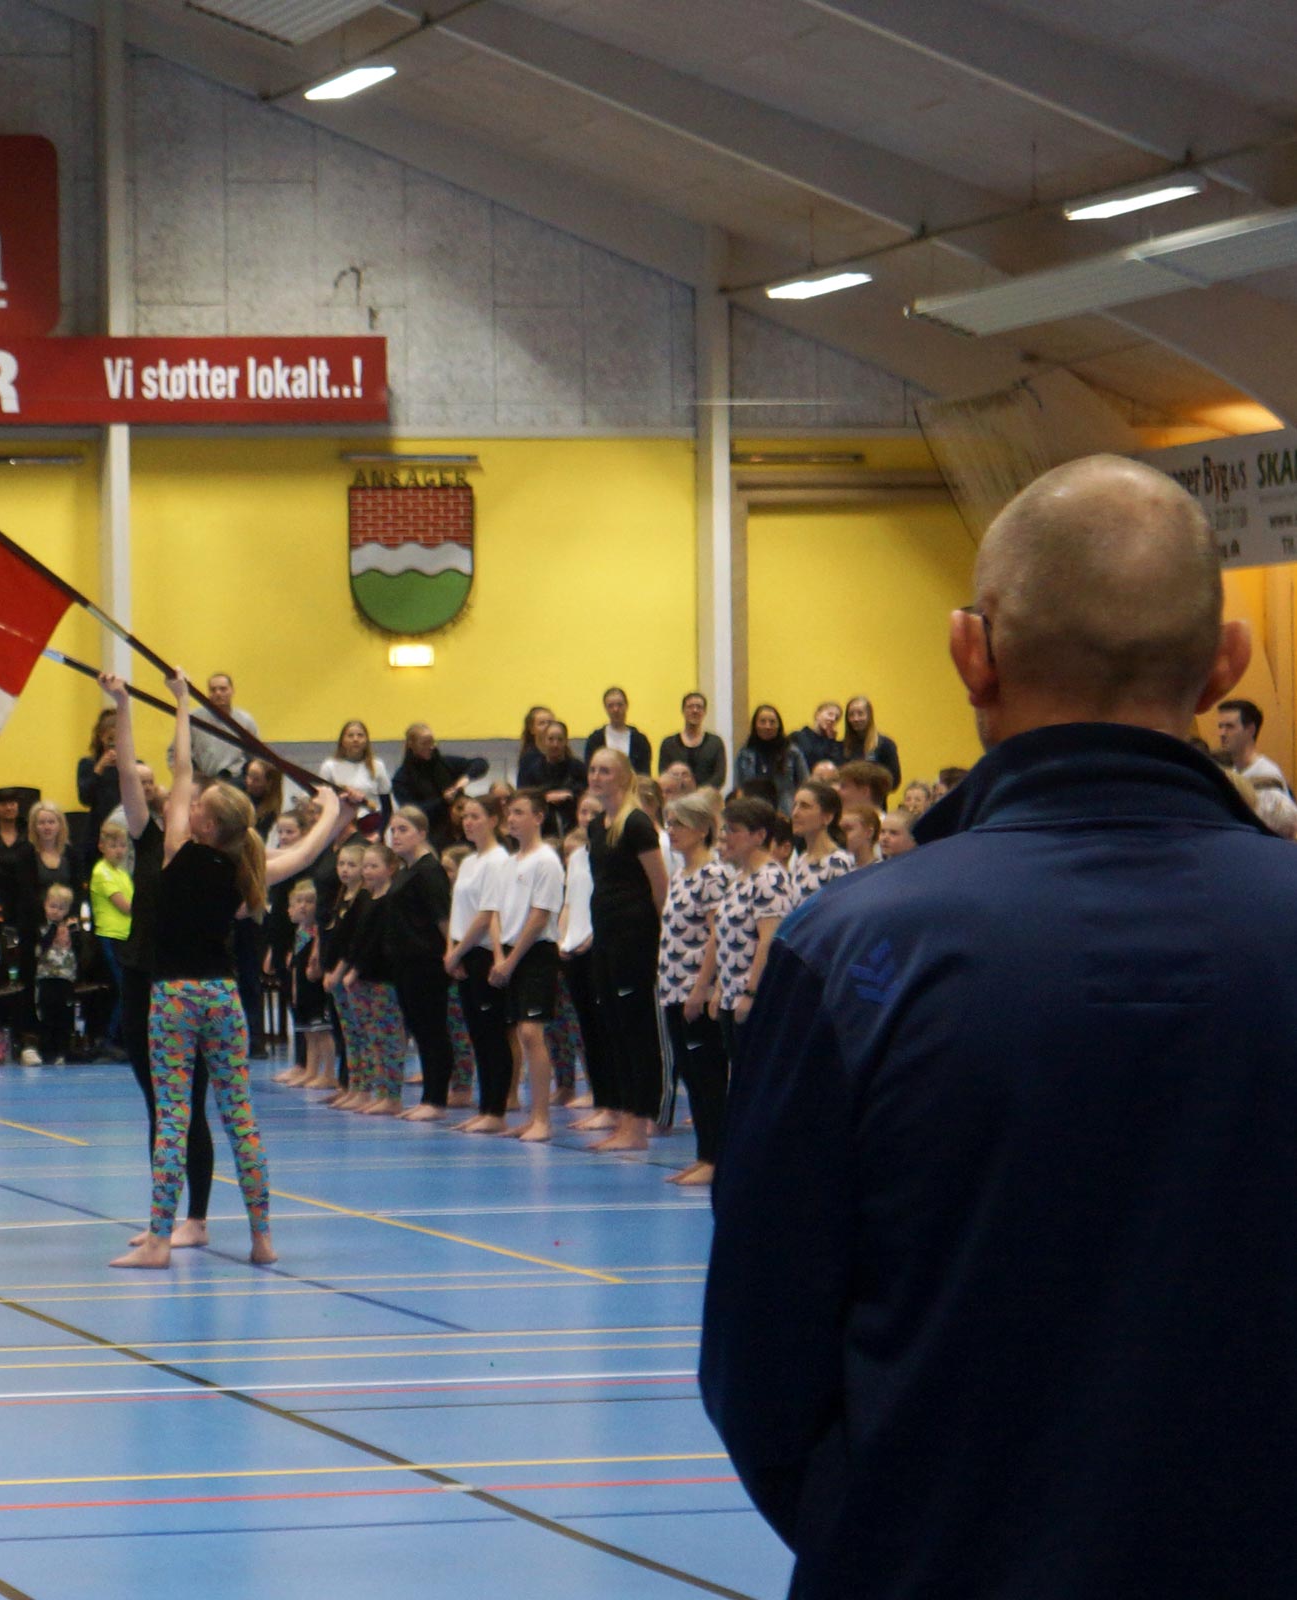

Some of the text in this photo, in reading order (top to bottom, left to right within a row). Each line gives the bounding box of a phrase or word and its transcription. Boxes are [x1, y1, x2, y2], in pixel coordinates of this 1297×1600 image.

[104, 356, 364, 402] Vi støtter lokalt..!
[352, 467, 471, 488] ANSAGER
[1257, 449, 1297, 489] SKA
